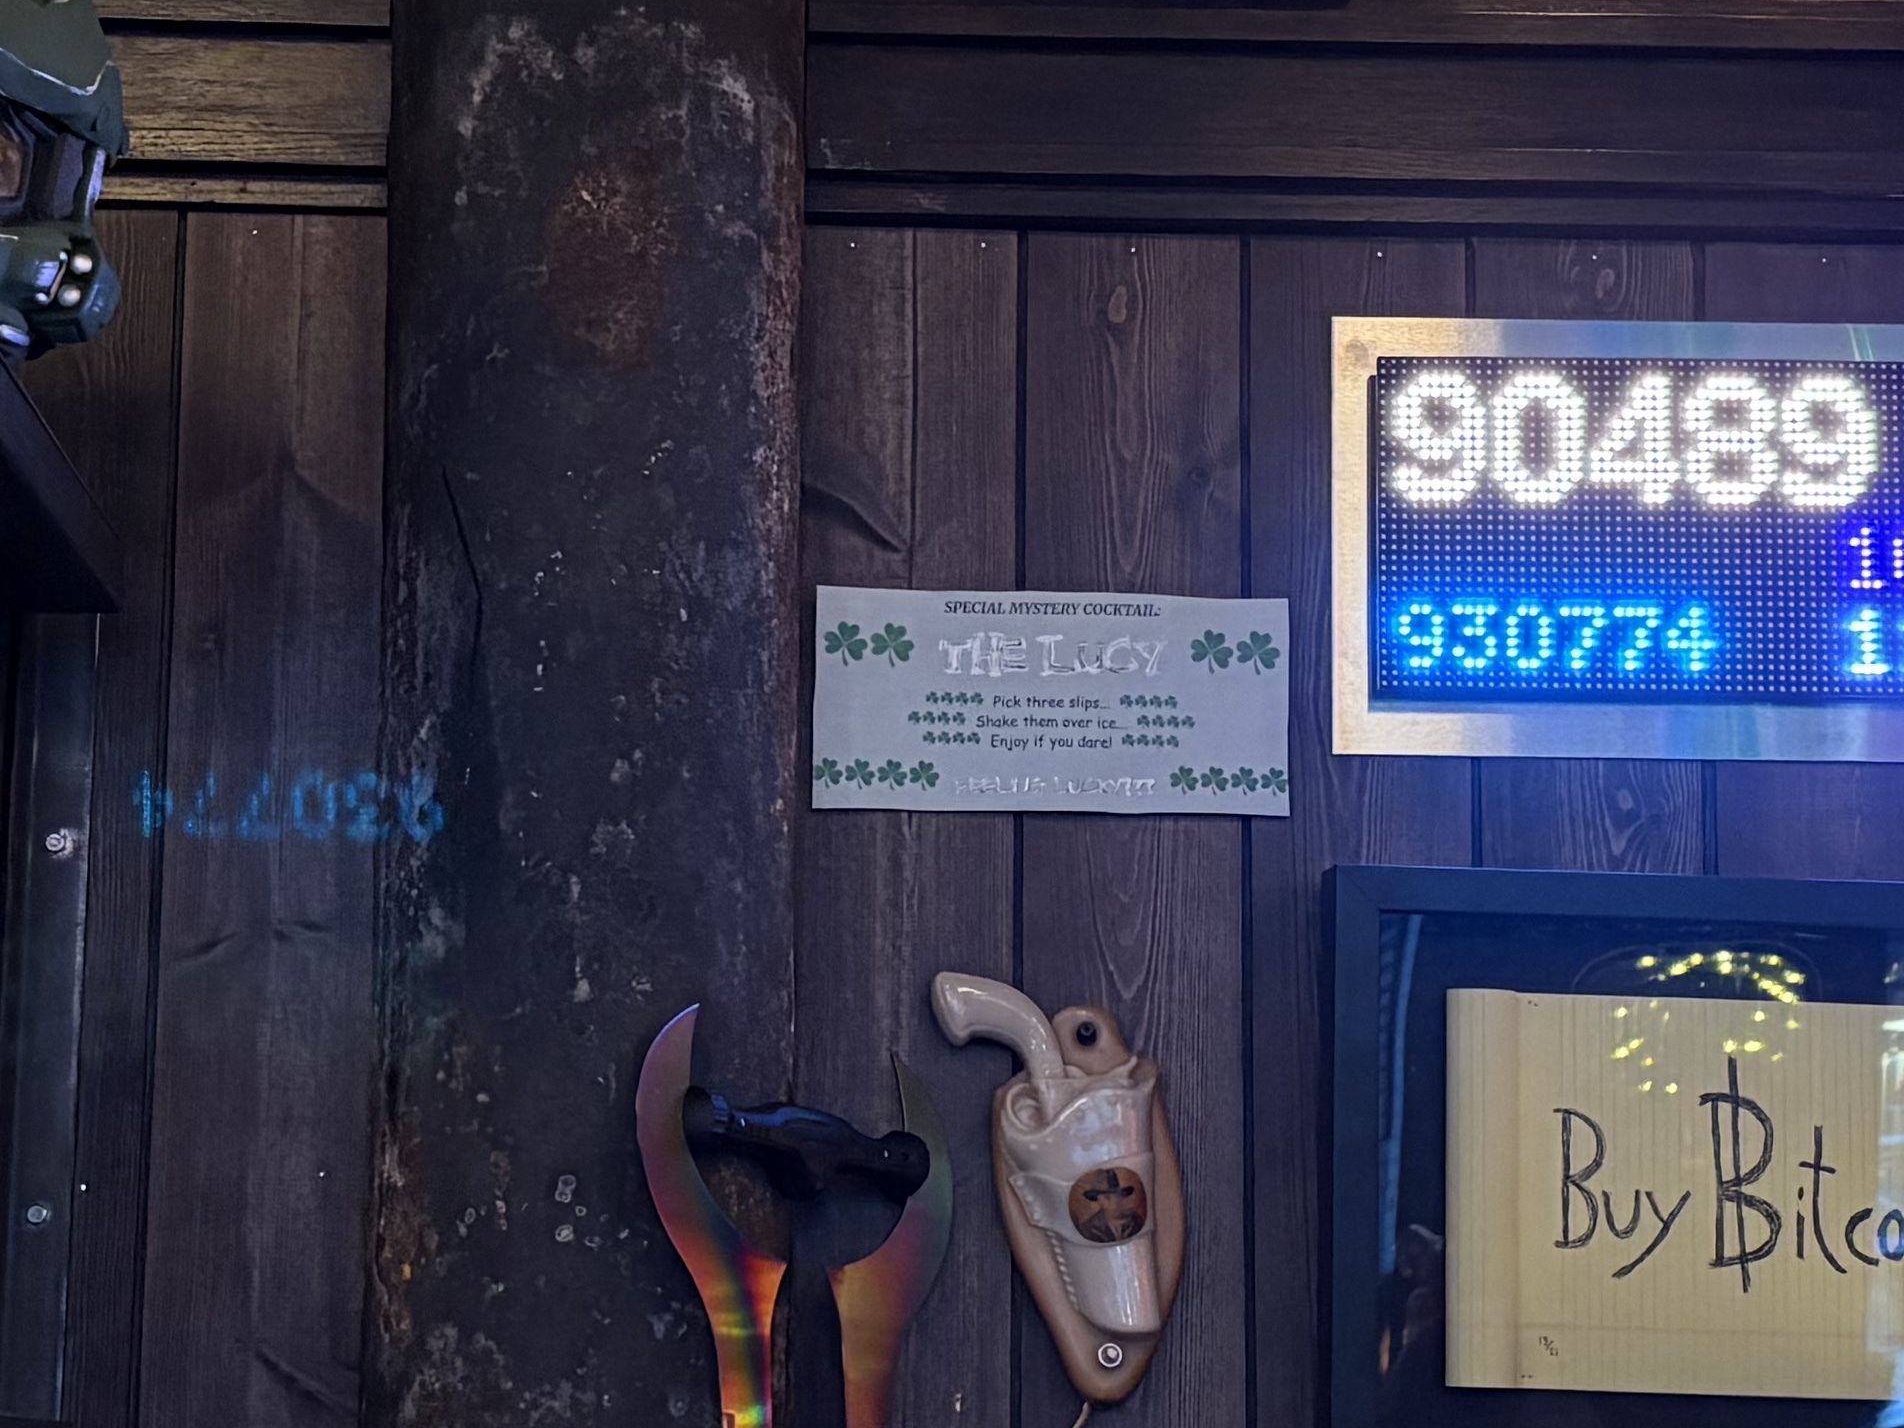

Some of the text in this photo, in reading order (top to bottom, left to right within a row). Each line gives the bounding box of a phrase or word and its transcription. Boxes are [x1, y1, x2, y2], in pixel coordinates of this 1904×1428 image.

[1391, 370, 1882, 509] 90489
[944, 601, 1161, 617] SPECIAL MYSTERY COCKTAIL:
[1396, 601, 1717, 673] 930774
[939, 632, 1168, 677] THE LUCY
[993, 695, 1021, 708] Pick
[1026, 696, 1064, 708] three
[976, 716, 1018, 729] Shake
[1023, 716, 1059, 729] them
[1062, 719, 1093, 729] over
[991, 734, 1112, 751] Enjoy if you dare!
[1551, 1105, 1691, 1281] Buy
